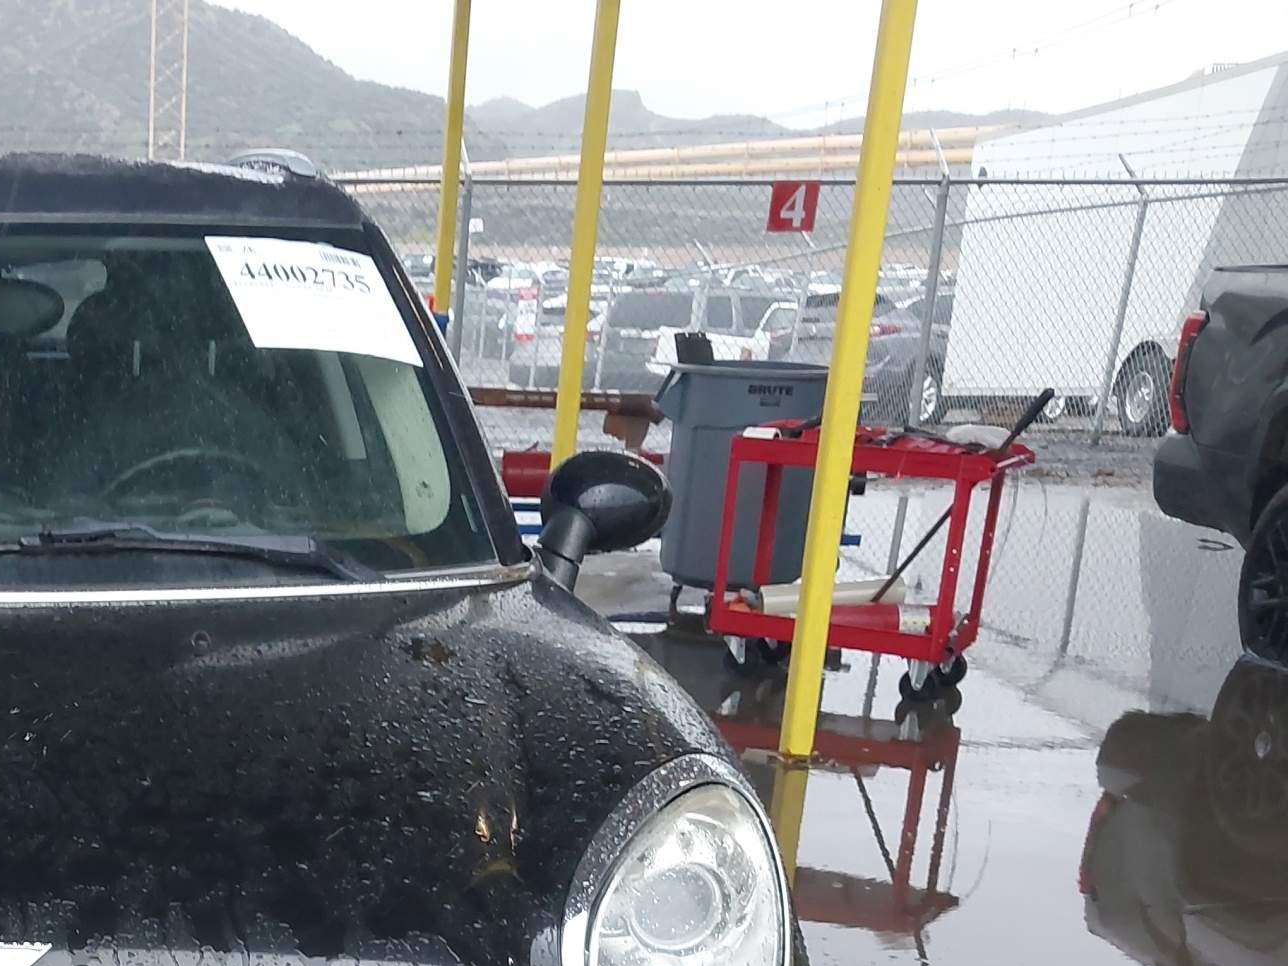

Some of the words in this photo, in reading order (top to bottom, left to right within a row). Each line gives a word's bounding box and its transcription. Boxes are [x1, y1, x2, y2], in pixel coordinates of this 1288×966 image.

[779, 184, 806, 227] 4
[240, 262, 371, 293] 44002735
[748, 384, 794, 396] BRUTE
